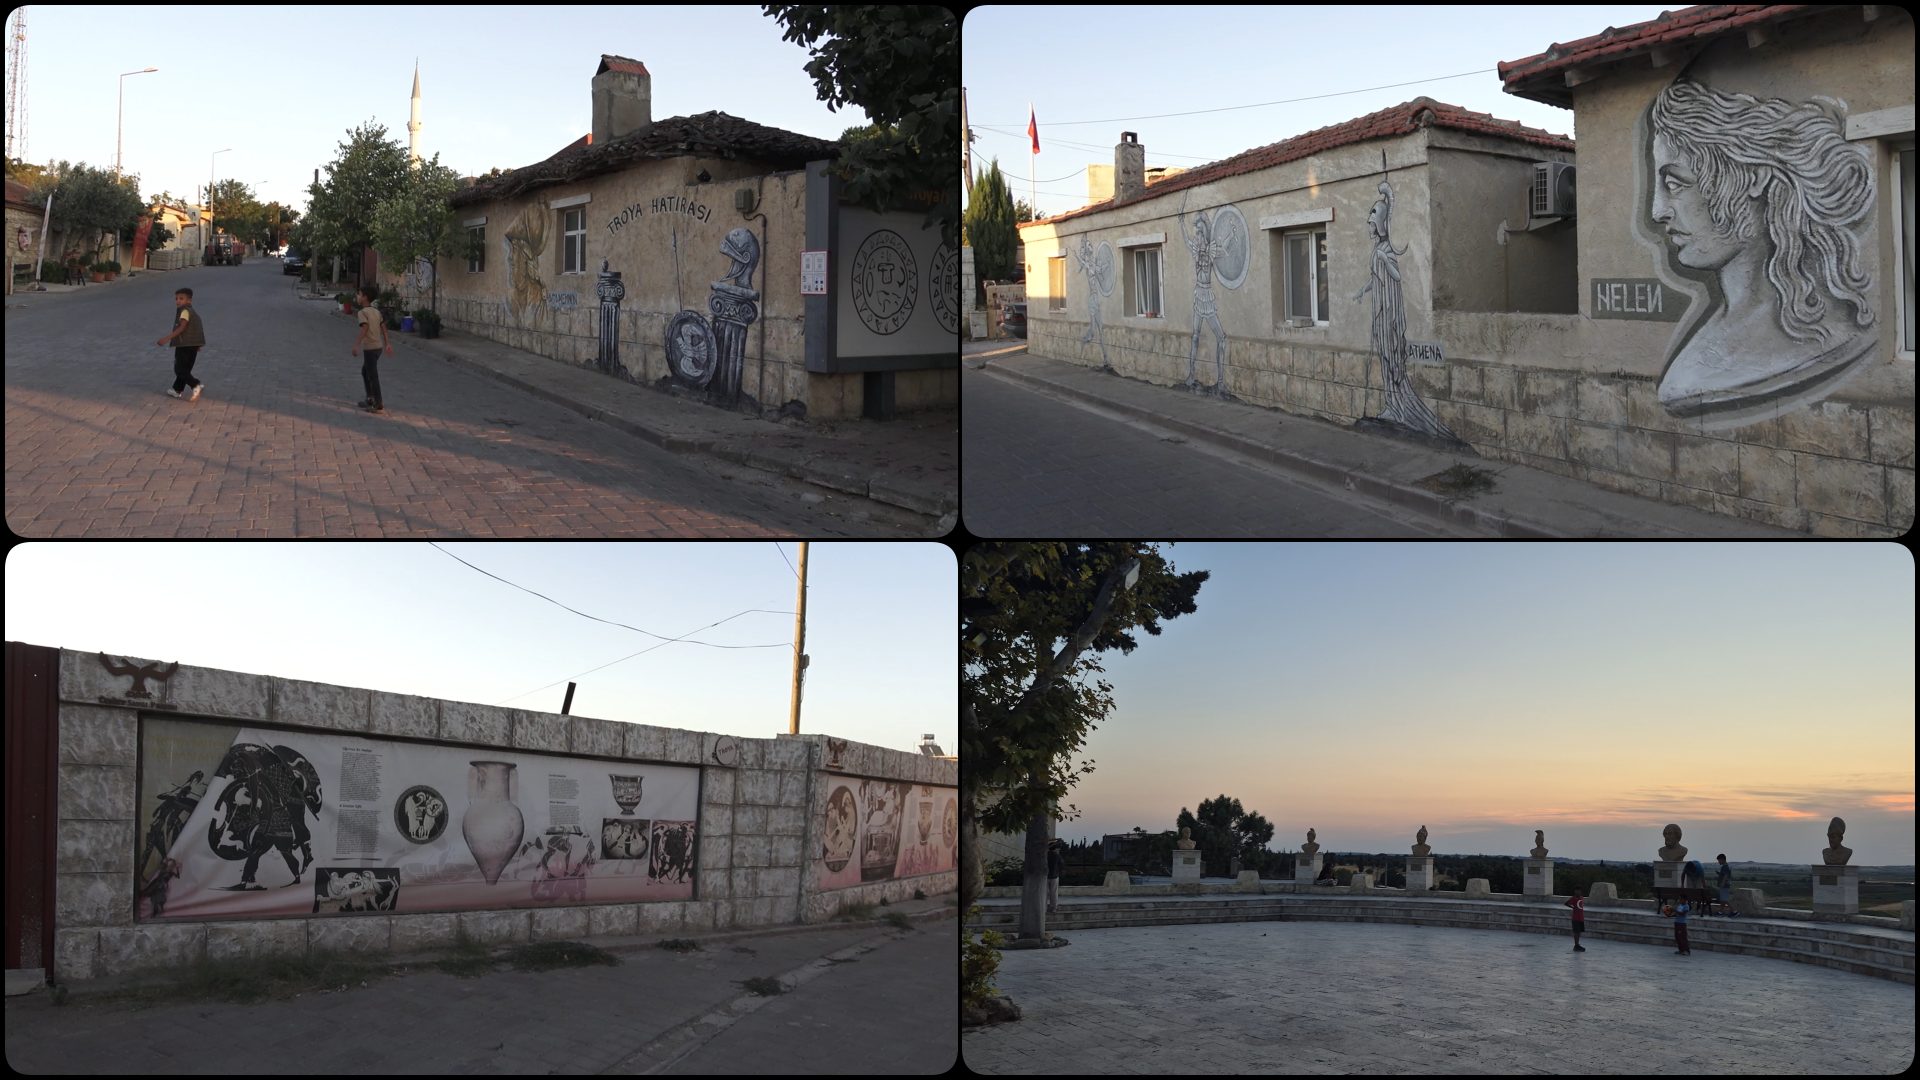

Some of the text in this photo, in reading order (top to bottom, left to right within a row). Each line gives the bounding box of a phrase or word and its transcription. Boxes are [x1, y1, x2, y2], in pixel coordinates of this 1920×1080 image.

[606, 196, 712, 235] TROYA HATIRASI
[1597, 283, 1663, 313] HELEN
[1408, 344, 1443, 361] ATHENA
